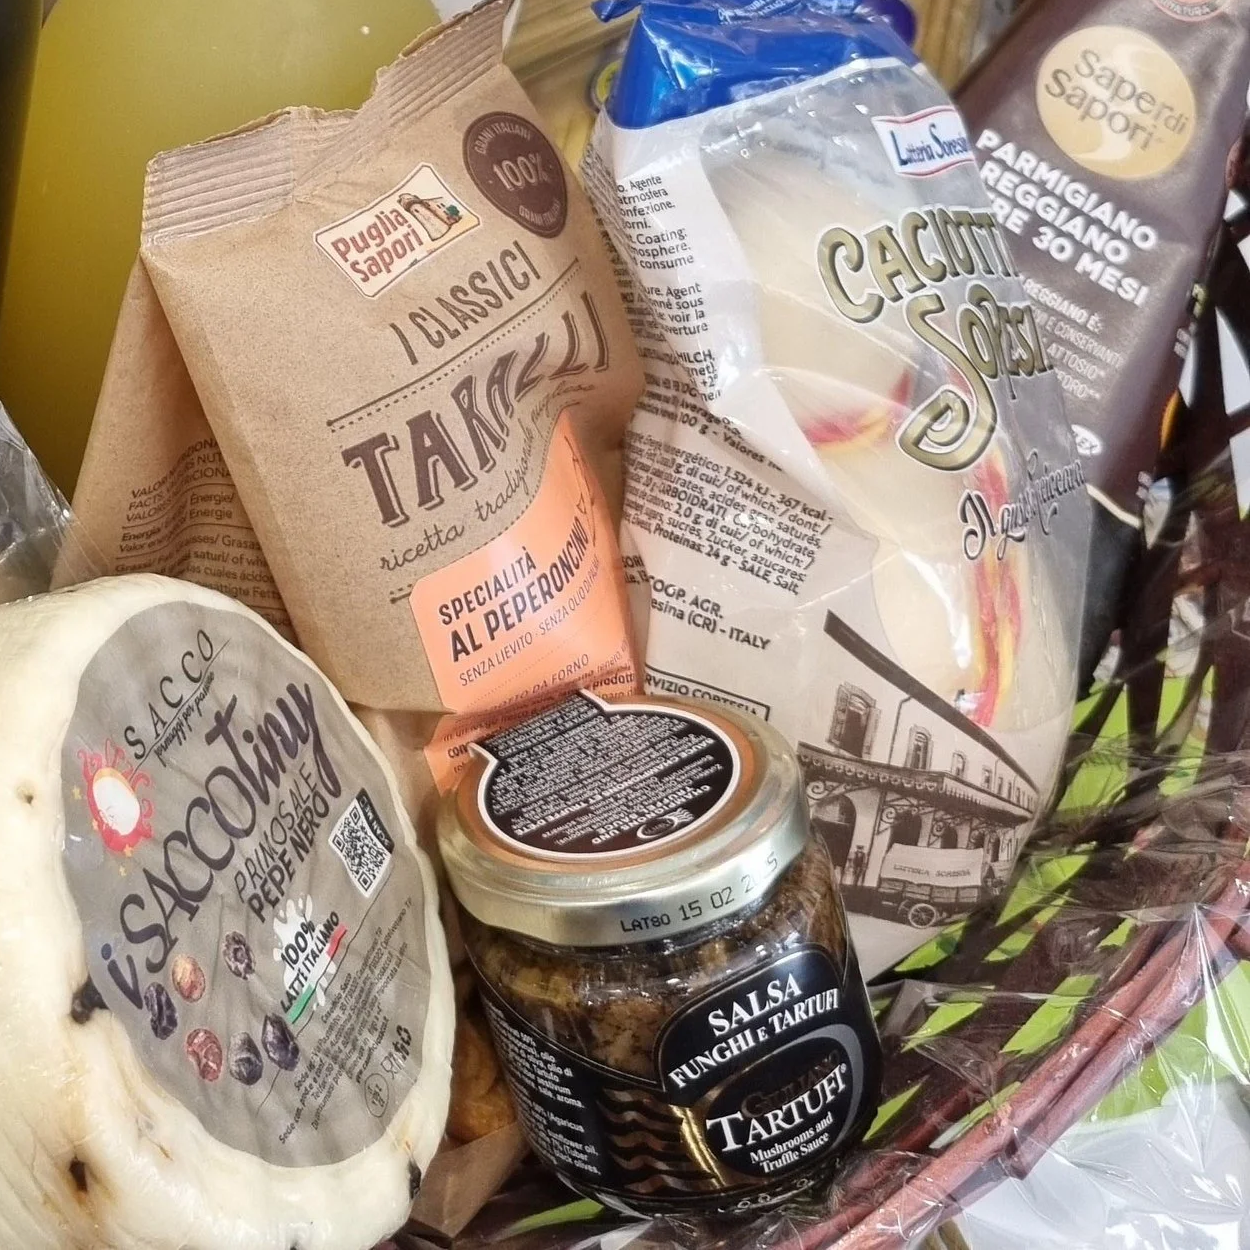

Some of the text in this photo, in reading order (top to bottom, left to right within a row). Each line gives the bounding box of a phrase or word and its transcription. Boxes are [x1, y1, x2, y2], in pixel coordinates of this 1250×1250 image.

[1045, 68, 1158, 151] Sapori
[493, 153, 550, 192] 100%
[630, 176, 662, 190] Agente
[976, 128, 1159, 249] PARMIGIANO
[331, 208, 408, 263] Puglia
[980, 159, 1130, 265] REGGIANO
[350, 225, 423, 283] Sapori
[640, 254, 694, 269] consume
[817, 206, 1018, 324] CACIOTT
[1033, 226, 1150, 306] 30 MESI
[390, 323, 418, 366] I
[408, 240, 541, 349] CLASSICI
[666, 283, 701, 298] Agent
[669, 310, 690, 323] voir
[675, 298, 703, 310] sous
[342, 291, 609, 528] TARALLI
[722, 433, 766, 465] Valores
[189, 507, 233, 520] Energie
[380, 523, 465, 573] ricetta
[475, 418, 539, 524] tradizionale
[709, 488, 822, 548] acides saturés,
[778, 492, 824, 522] 367 kcal
[706, 528, 807, 584] Zucker, azucares:
[739, 558, 800, 598] SALE, Salt,
[439, 547, 537, 627] SPECIALITÀ
[452, 516, 589, 662] AL PEPERONCINO
[689, 597, 725, 620] AGR.
[459, 604, 569, 687] SENZA LIEVITO SENZA
[687, 608, 771, 652] (CR) ITALY
[124, 630, 214, 760] SACCO
[550, 654, 590, 691] FORNO
[154, 717, 188, 768] formaggi
[234, 763, 318, 904] PRIMOSALE
[246, 790, 331, 923] PEPE NERO
[679, 901, 703, 923] 15
[711, 884, 735, 910] 02
[280, 911, 340, 1013] LATTE ITALIANO
[281, 919, 316, 968] 100%
[708, 974, 803, 1037] SALSA
[668, 987, 840, 1089] FUNGHI TARTUFI
[706, 1064, 844, 1152] TARTUFI
[750, 1112, 834, 1164] Mushrooms and
[759, 1131, 830, 1175] Truffle Sauce
